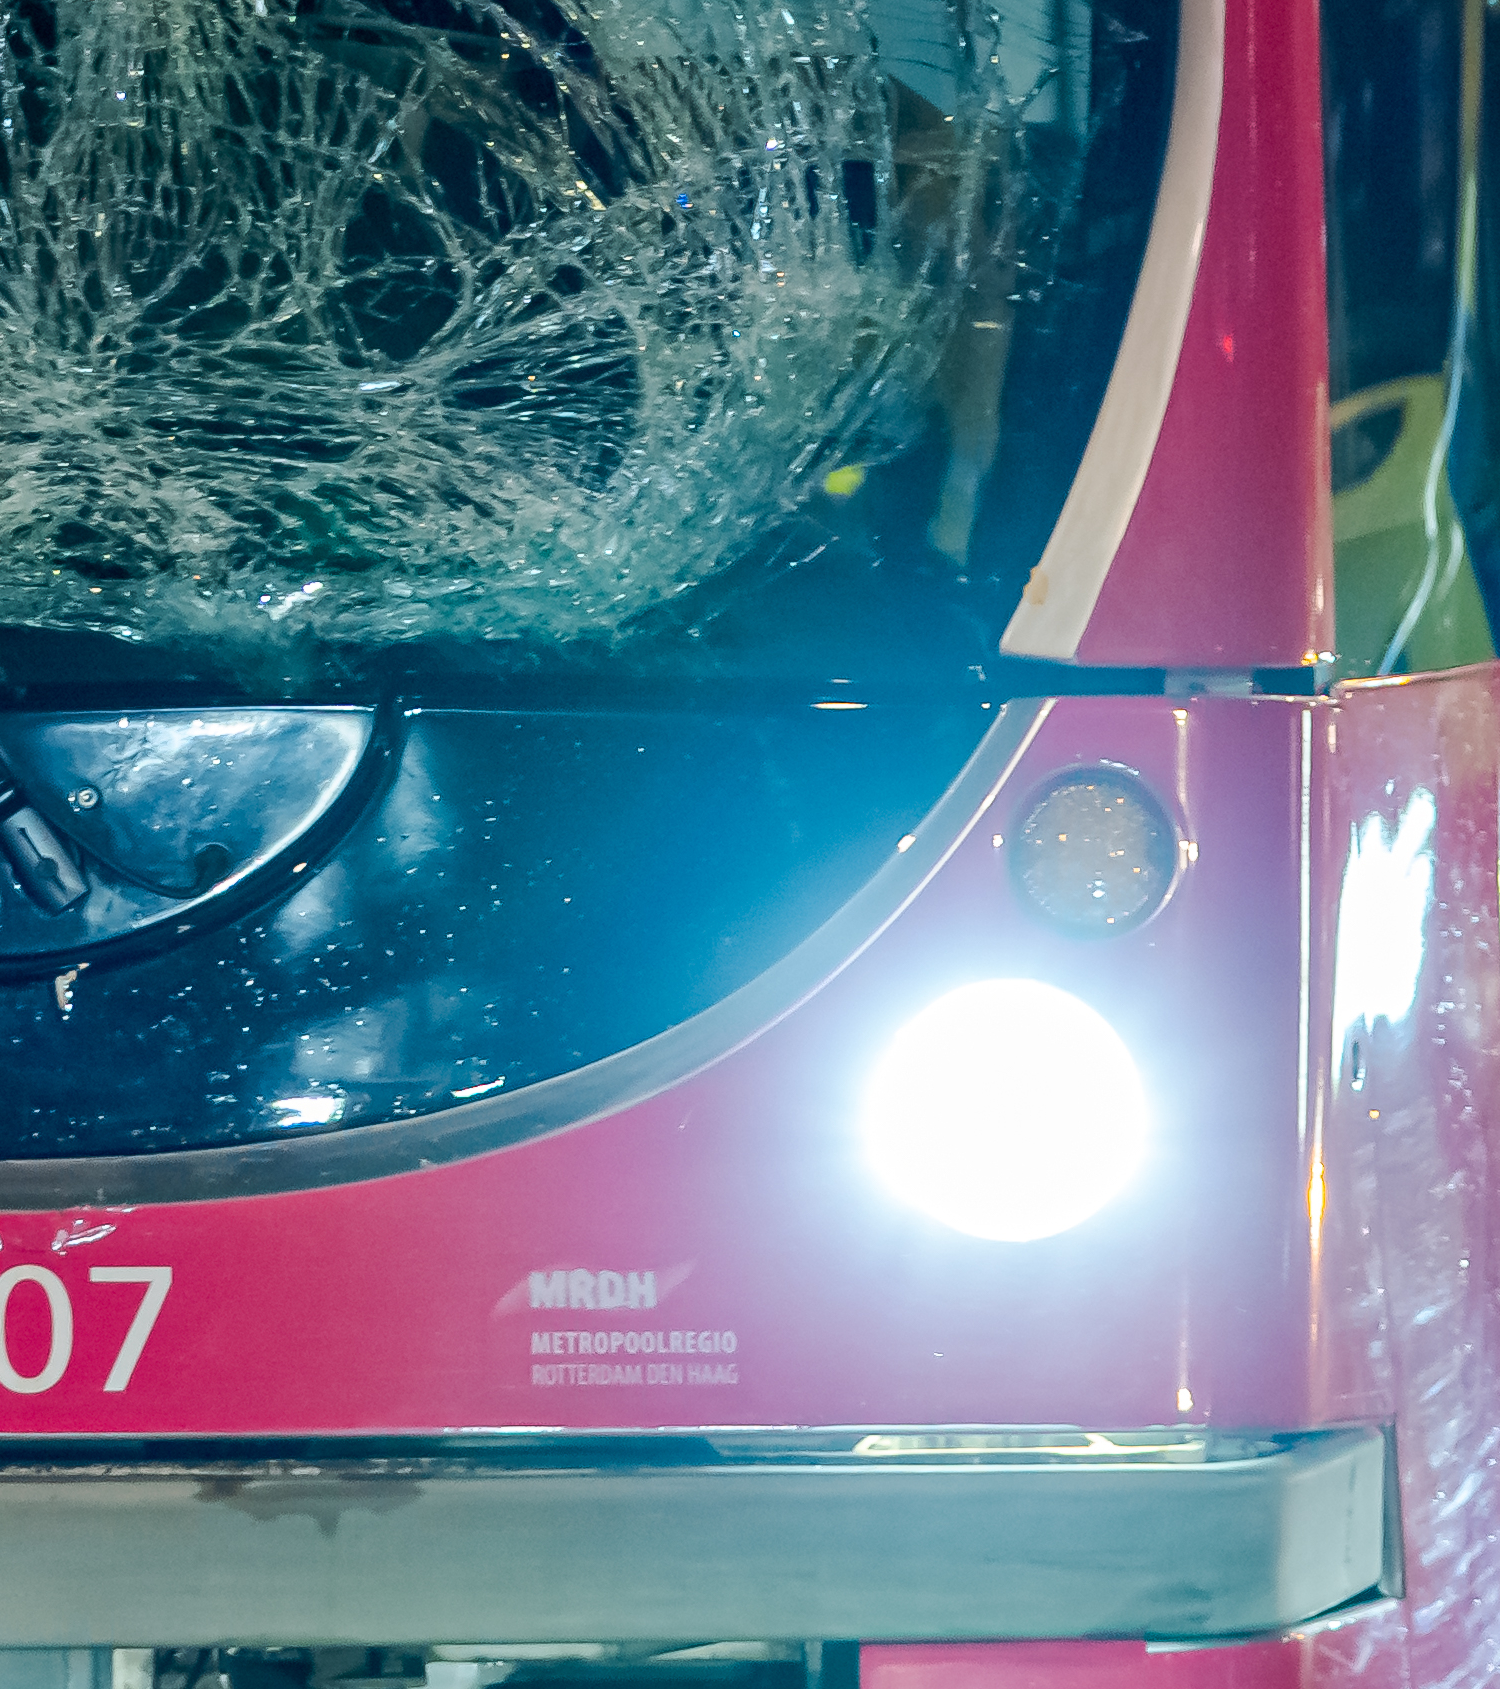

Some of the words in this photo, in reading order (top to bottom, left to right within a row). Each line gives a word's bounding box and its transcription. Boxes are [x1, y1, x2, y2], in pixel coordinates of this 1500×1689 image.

[529, 1269, 657, 1309] MRDH
[531, 1332, 738, 1354] METROPOOLREGIO
[531, 1364, 642, 1385] ROTTERDAM
[648, 1364, 684, 1385] DEN
[689, 1364, 739, 1385] HAAG
